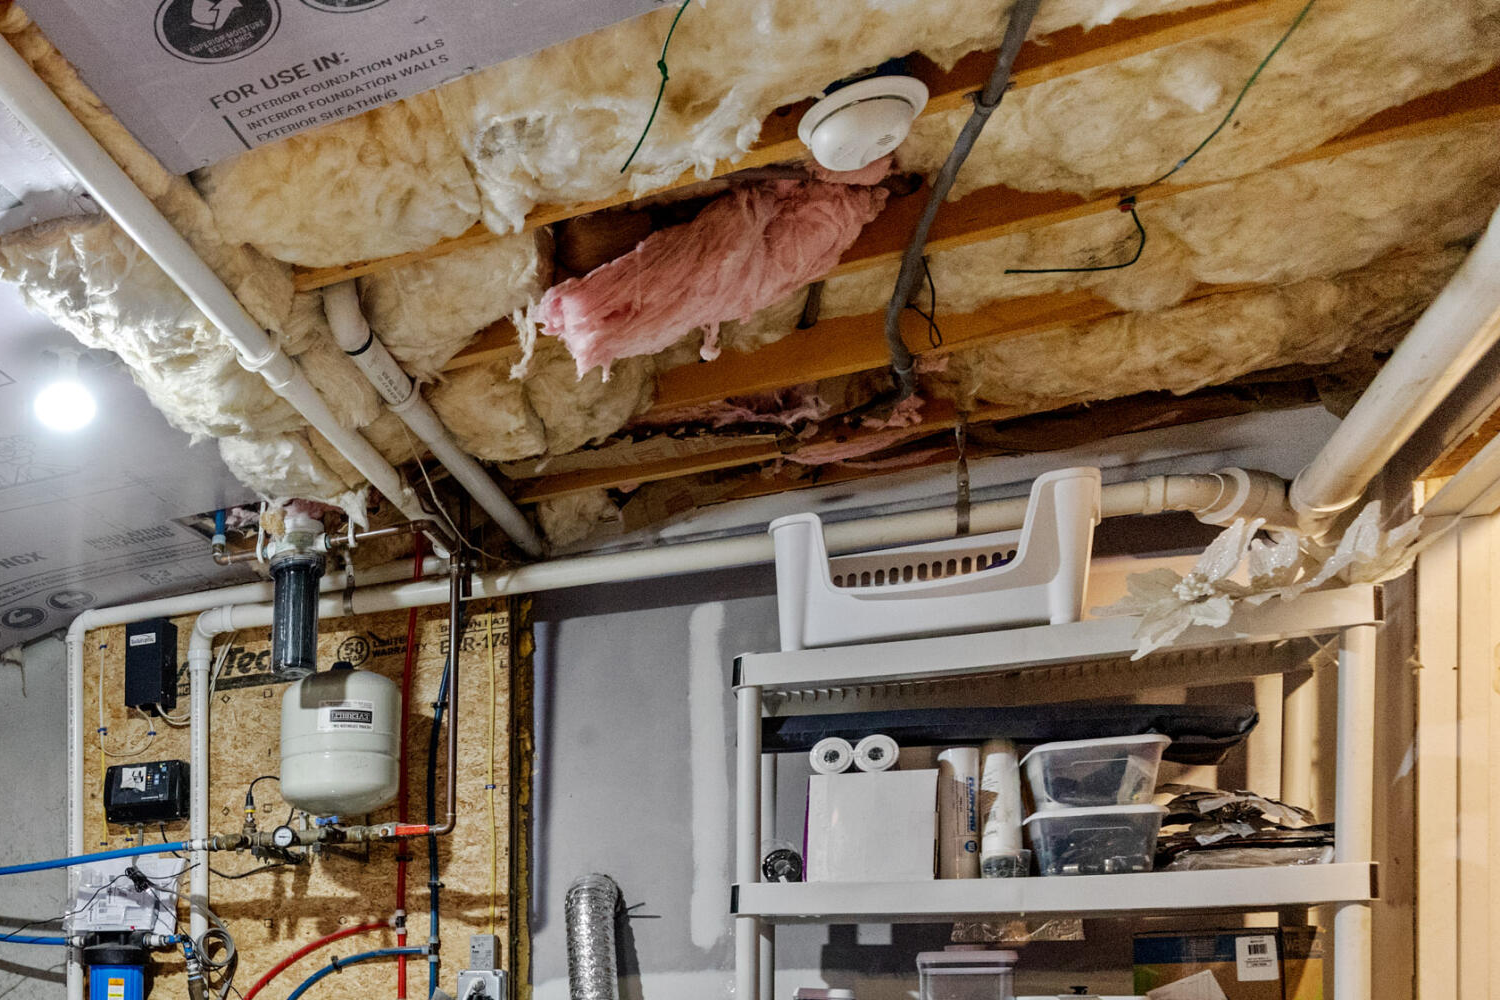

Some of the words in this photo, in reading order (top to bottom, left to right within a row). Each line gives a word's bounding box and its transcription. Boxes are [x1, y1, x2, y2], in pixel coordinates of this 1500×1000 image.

[209, 82, 258, 109] FOR
[260, 63, 311, 91] USE
[312, 48, 350, 71] IN:
[238, 90, 301, 119] EXTERIOR
[302, 57, 393, 96] FOUNDATION
[393, 38, 445, 62] WALLS
[246, 104, 307, 131] INTERIOR
[308, 72, 397, 109] FOUNDATION
[398, 53, 449, 77] WALLS
[255, 116, 317, 141] EXTERIOR
[320, 87, 398, 121] SHEATHING
[344, 641, 363, 656] 50
[372, 642, 428, 659] WARRATY
